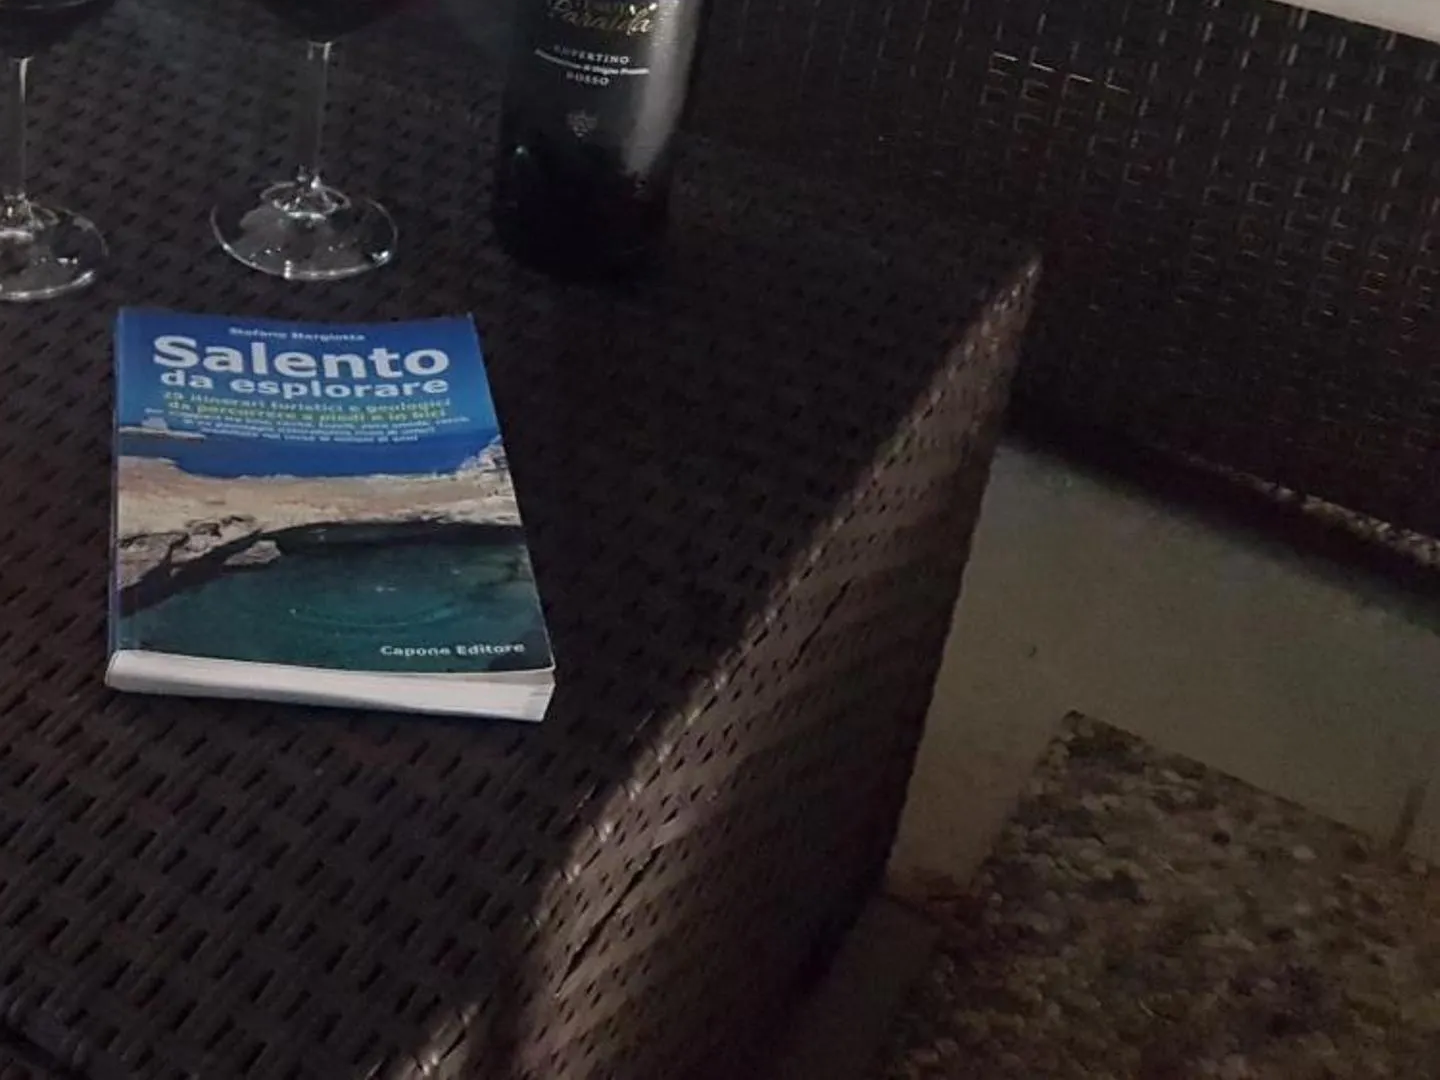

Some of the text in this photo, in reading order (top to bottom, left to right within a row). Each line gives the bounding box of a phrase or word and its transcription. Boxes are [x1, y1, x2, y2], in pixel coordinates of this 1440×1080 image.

[553, 44, 630, 65] PERTINO
[153, 335, 450, 379] Salento
[160, 369, 450, 400] da esplorare
[379, 643, 526, 658] Capone Editore
